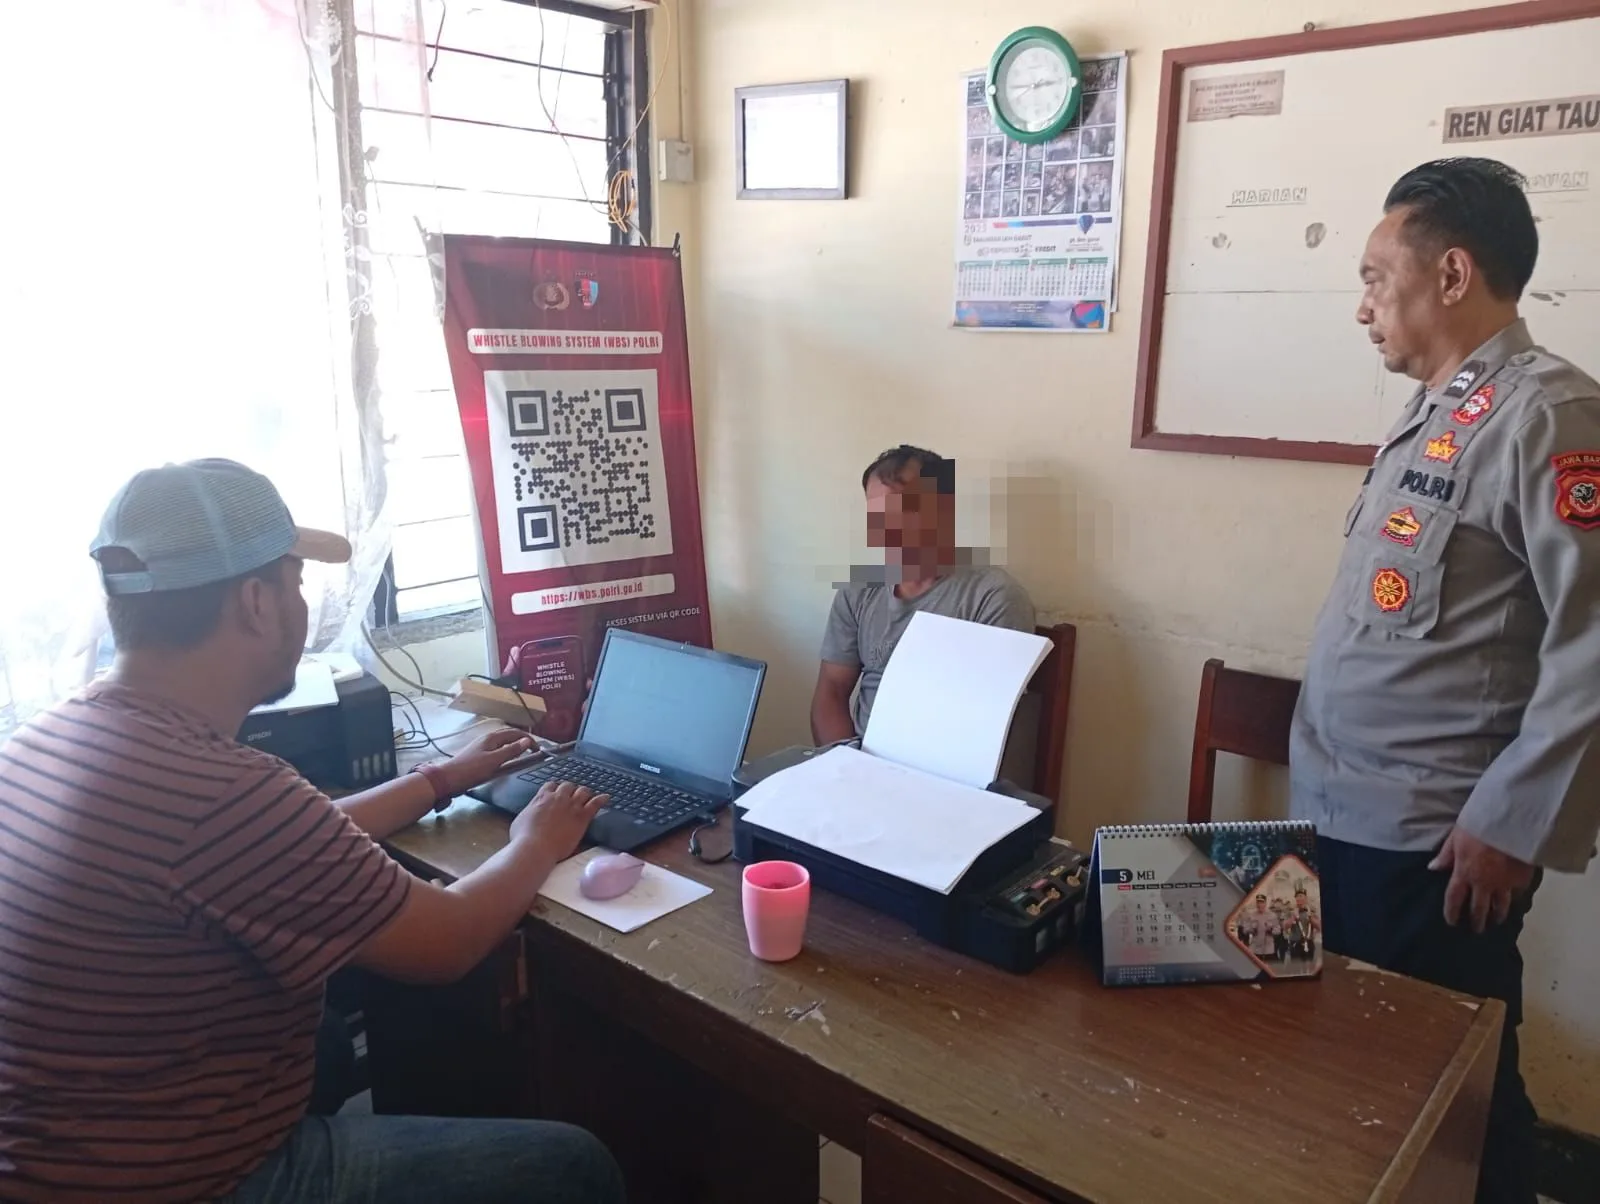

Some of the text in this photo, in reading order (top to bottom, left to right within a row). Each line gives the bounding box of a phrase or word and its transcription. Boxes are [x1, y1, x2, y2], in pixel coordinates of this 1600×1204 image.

[1448, 110, 1491, 138] REN
[1498, 105, 1550, 134] GIAT
[1231, 187, 1307, 205] HARIAN
[473, 334, 660, 349] WHISTLE BLOWING SYSTEM (WBS) POLRI
[1398, 469, 1456, 502] POLRI
[627, 613, 654, 625] SISTEM
[656, 612, 668, 621] VIA
[670, 610, 680, 620] QR
[681, 607, 700, 617] CODE
[536, 661, 565, 671] WHISTLE
[535, 668, 567, 678] BLOWING
[528, 677, 553, 686] SYSTEM
[541, 683, 562, 691] POLRI
[1119, 870, 1155, 882] 5 MEI
